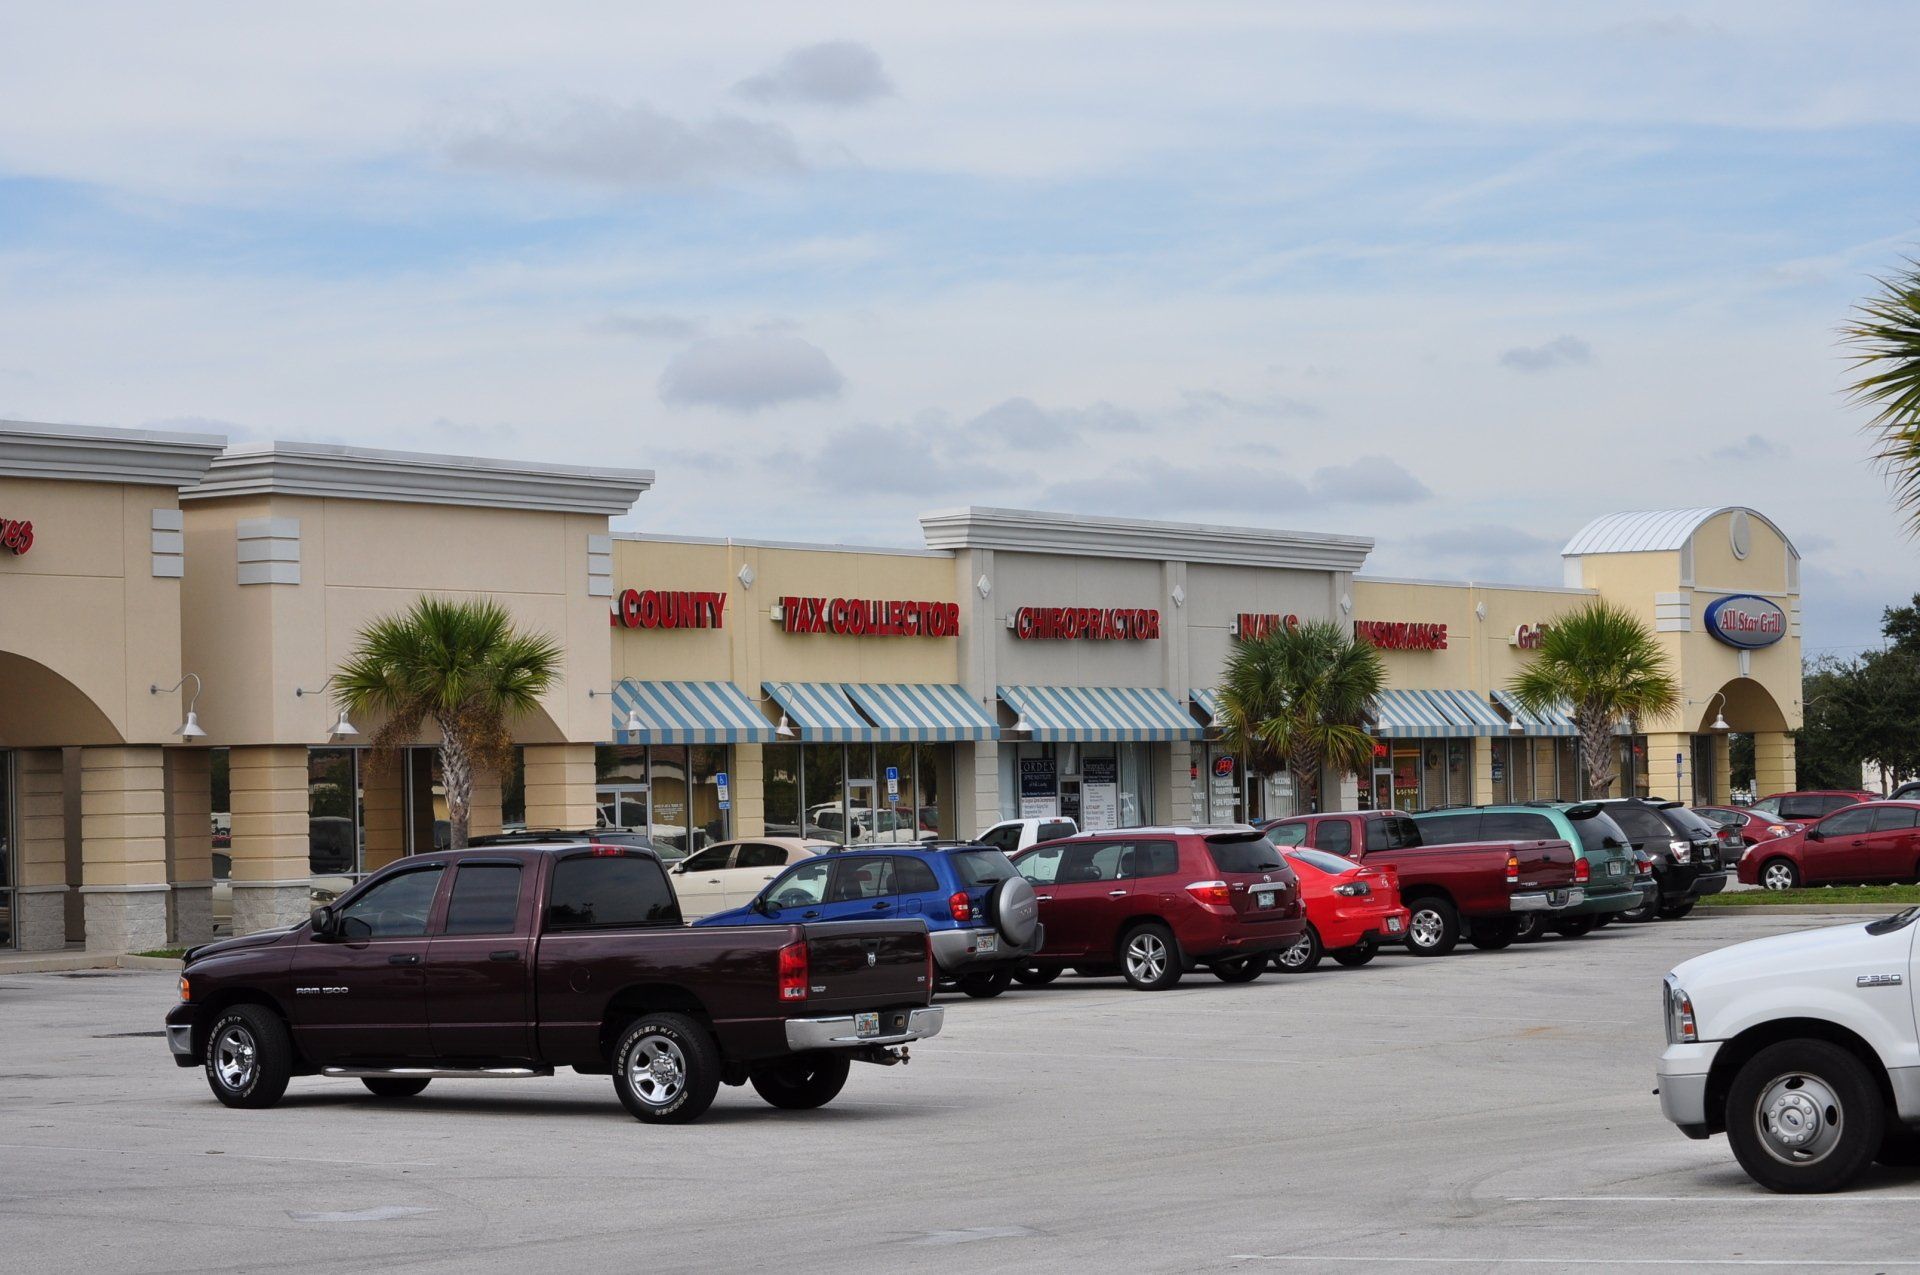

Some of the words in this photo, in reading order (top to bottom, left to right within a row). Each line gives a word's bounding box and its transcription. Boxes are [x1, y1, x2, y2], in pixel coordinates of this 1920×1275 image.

[620, 588, 728, 629] COUNTY
[779, 596, 827, 633] TAX
[829, 597, 960, 637] COLLECTOR
[1015, 606, 1160, 640] CHIROPRACTOR
[1720, 607, 1736, 631] All
[1738, 611, 1759, 632] Star
[1760, 611, 1781, 634] Grill
[1354, 620, 1449, 650] INSURANCE
